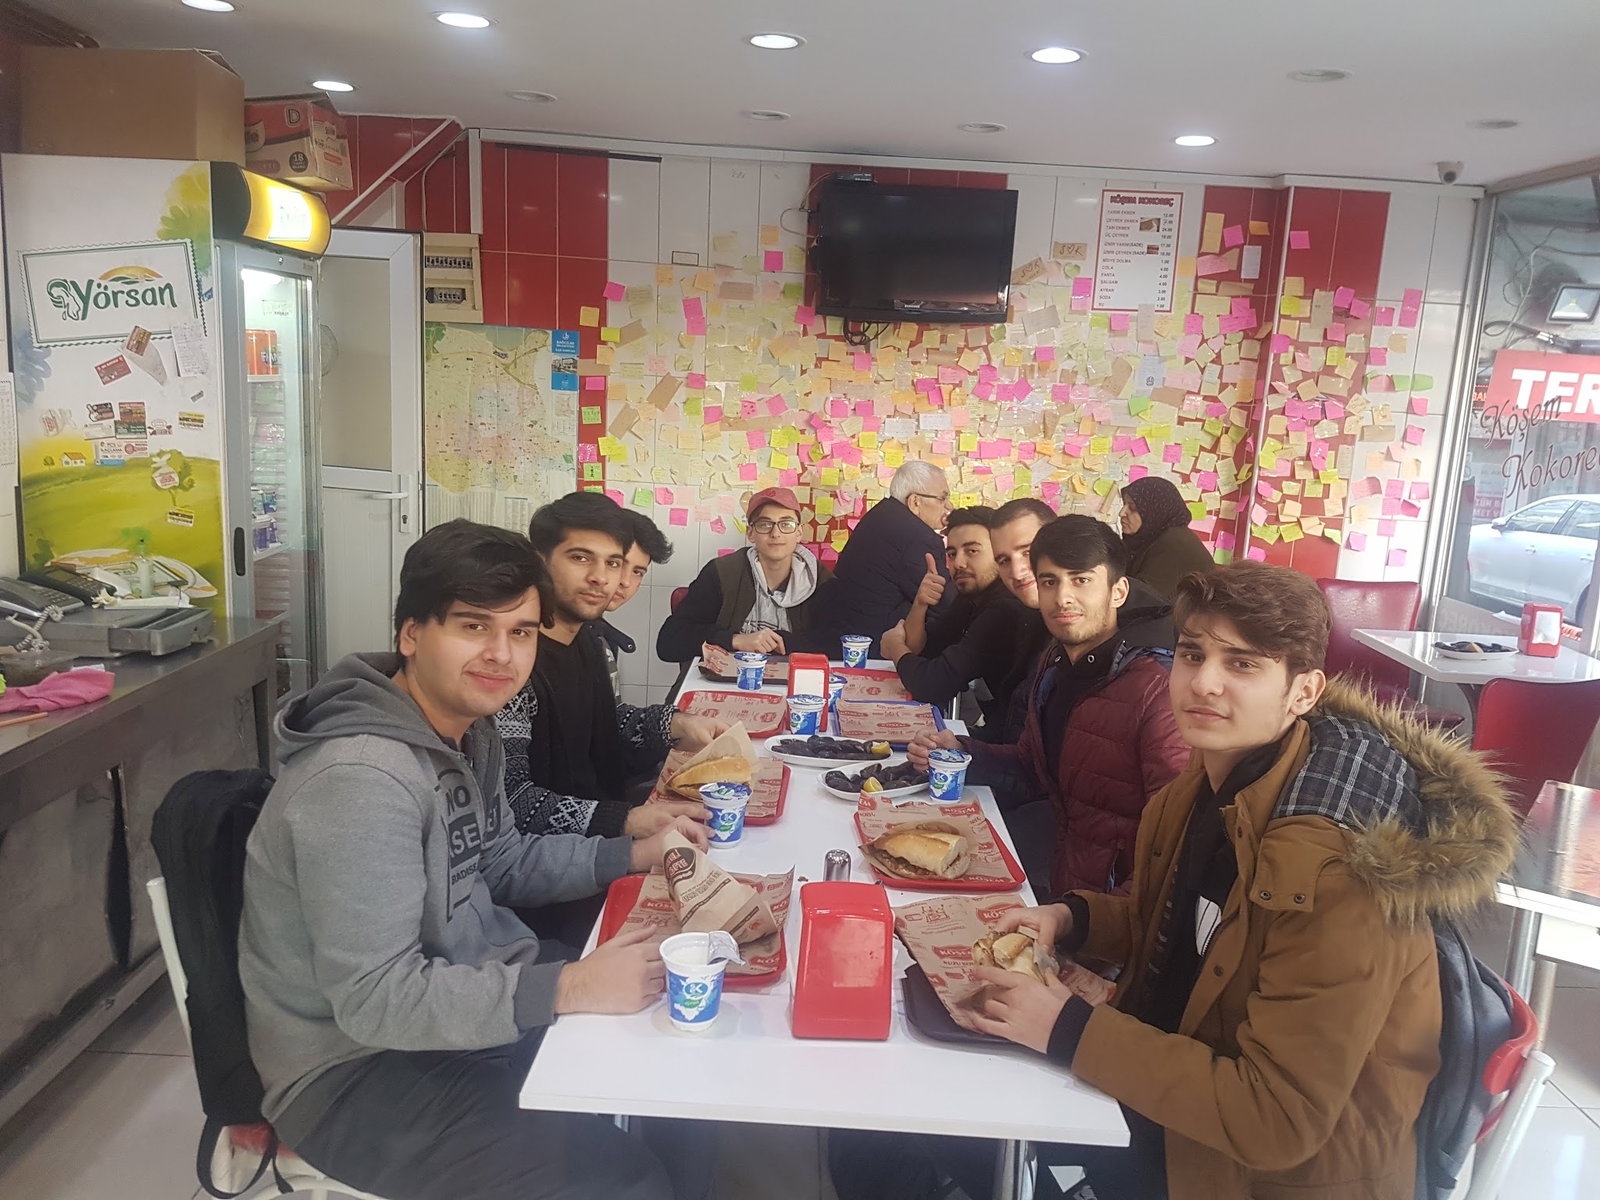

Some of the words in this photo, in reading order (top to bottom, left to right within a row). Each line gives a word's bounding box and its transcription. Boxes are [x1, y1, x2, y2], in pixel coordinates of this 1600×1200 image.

[69, 278, 178, 321] Yörsan
[1480, 395, 1562, 448] Köşem
[1502, 444, 1600, 498] Kokore
